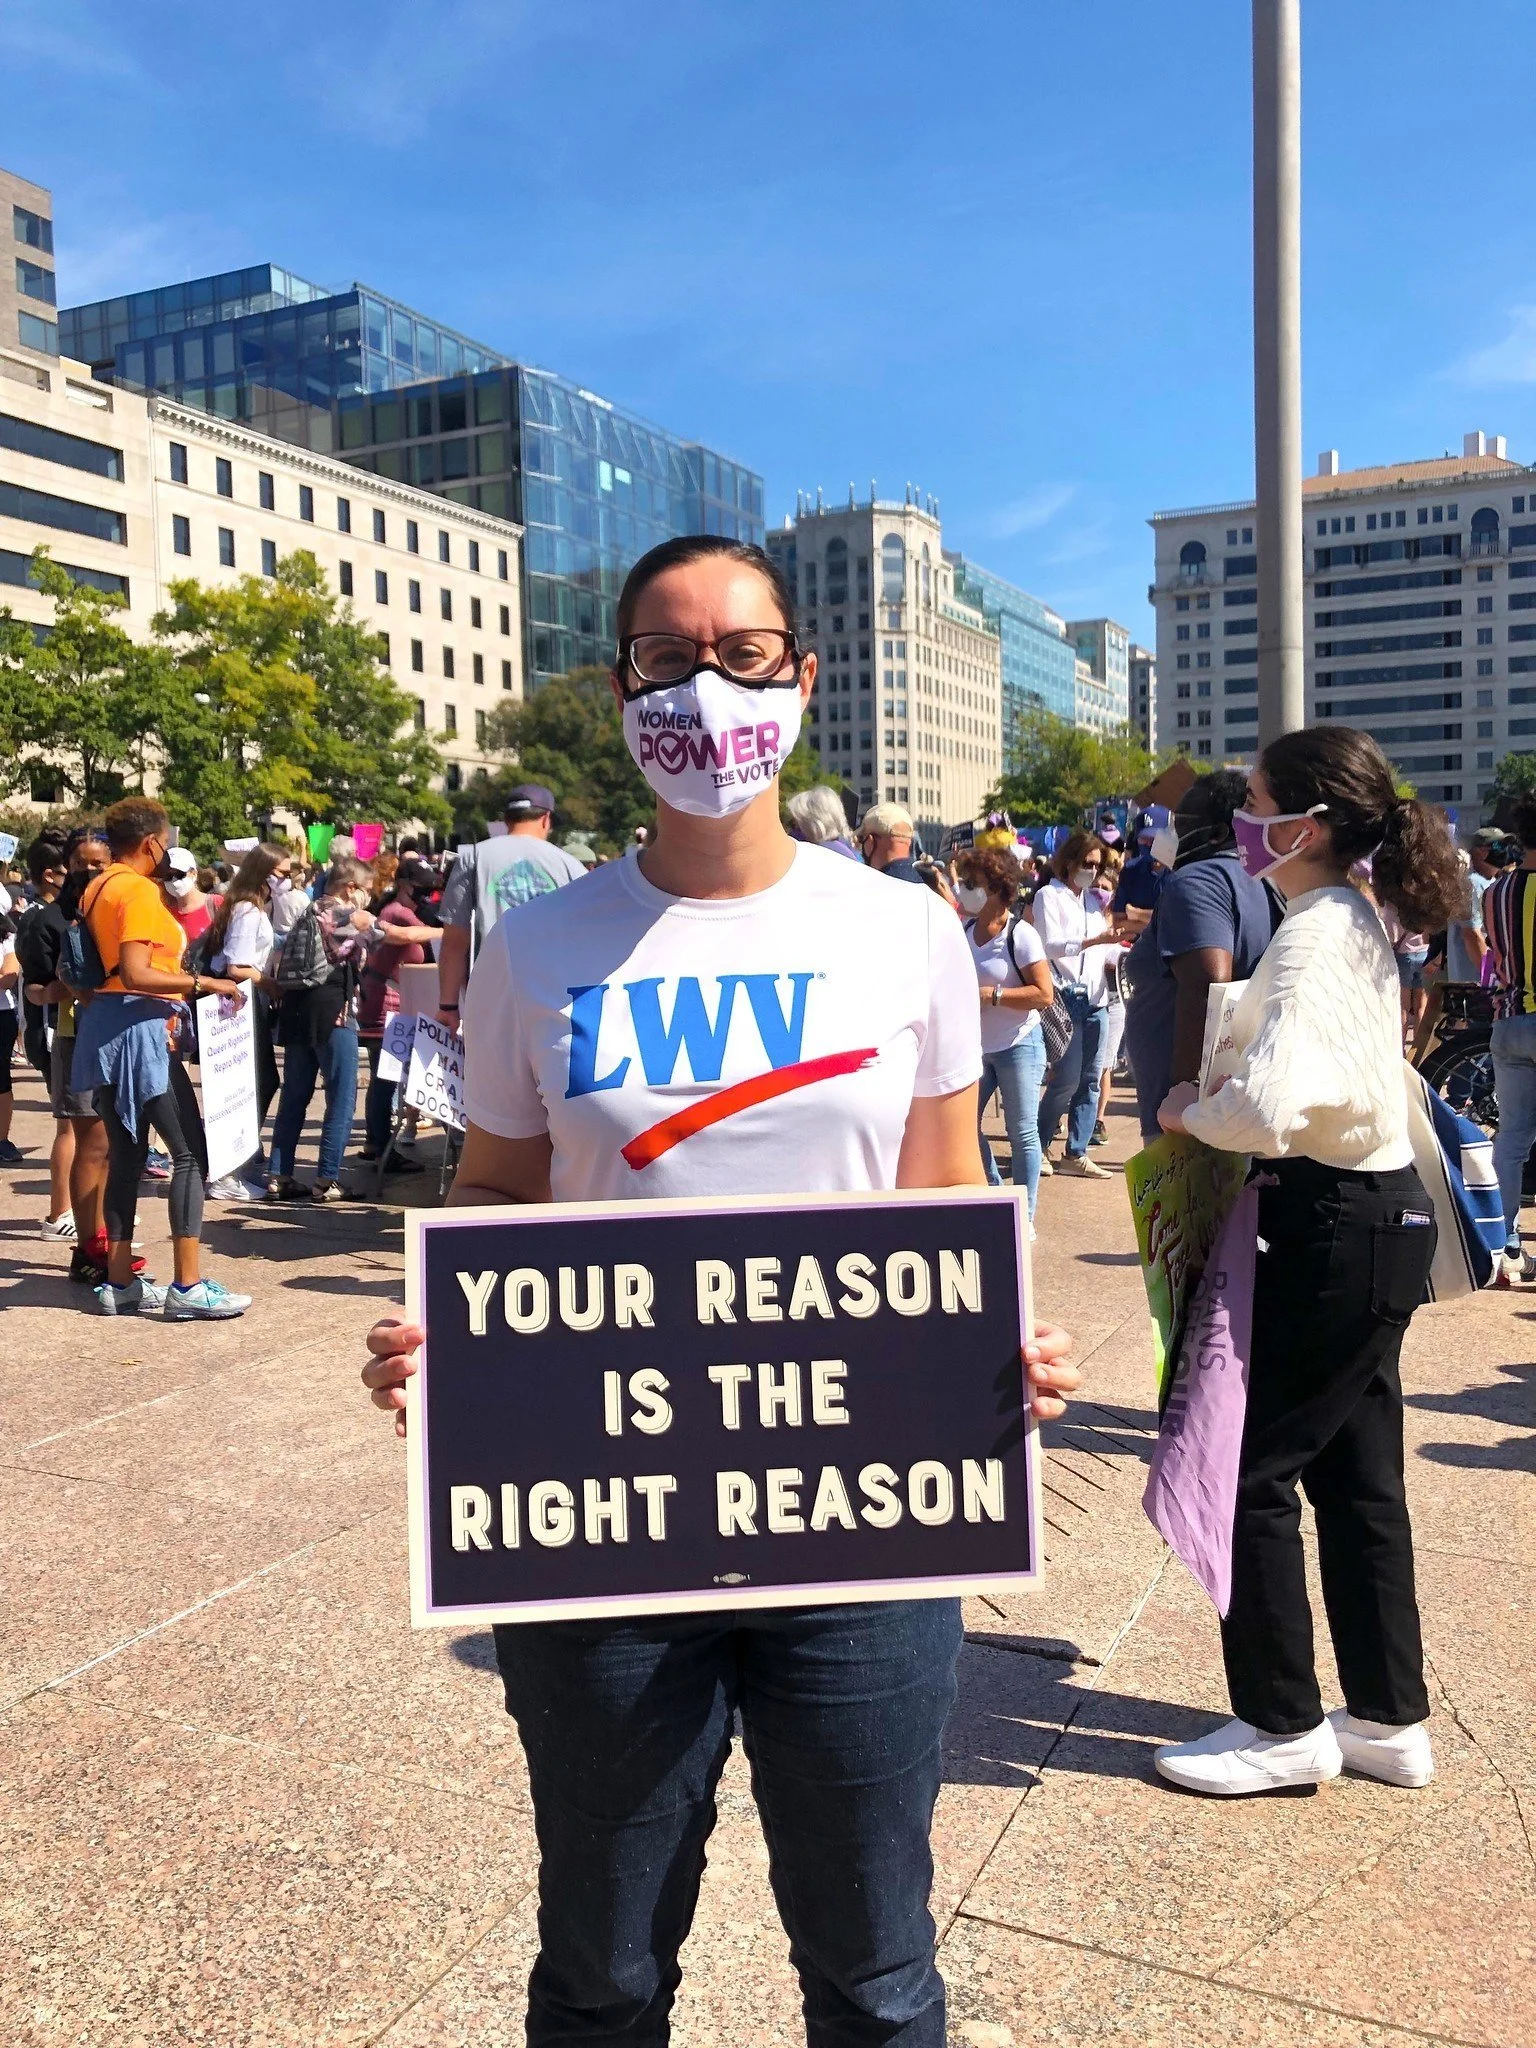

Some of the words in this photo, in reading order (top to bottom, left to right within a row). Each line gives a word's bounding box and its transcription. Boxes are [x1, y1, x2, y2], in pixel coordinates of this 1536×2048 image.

[637, 710, 702, 730] WOMEN
[639, 720, 780, 775] POWER
[711, 771, 735, 784] THE
[734, 758, 779, 784] VOTE
[207, 1042, 227, 1058] Queer
[456, 1262, 656, 1336] YOUR
[695, 1248, 983, 1325] REASON
[603, 1367, 673, 1436] IS
[708, 1359, 850, 1430] THE
[449, 1474, 677, 1551] RIGHT
[715, 1457, 1005, 1537] REASON
